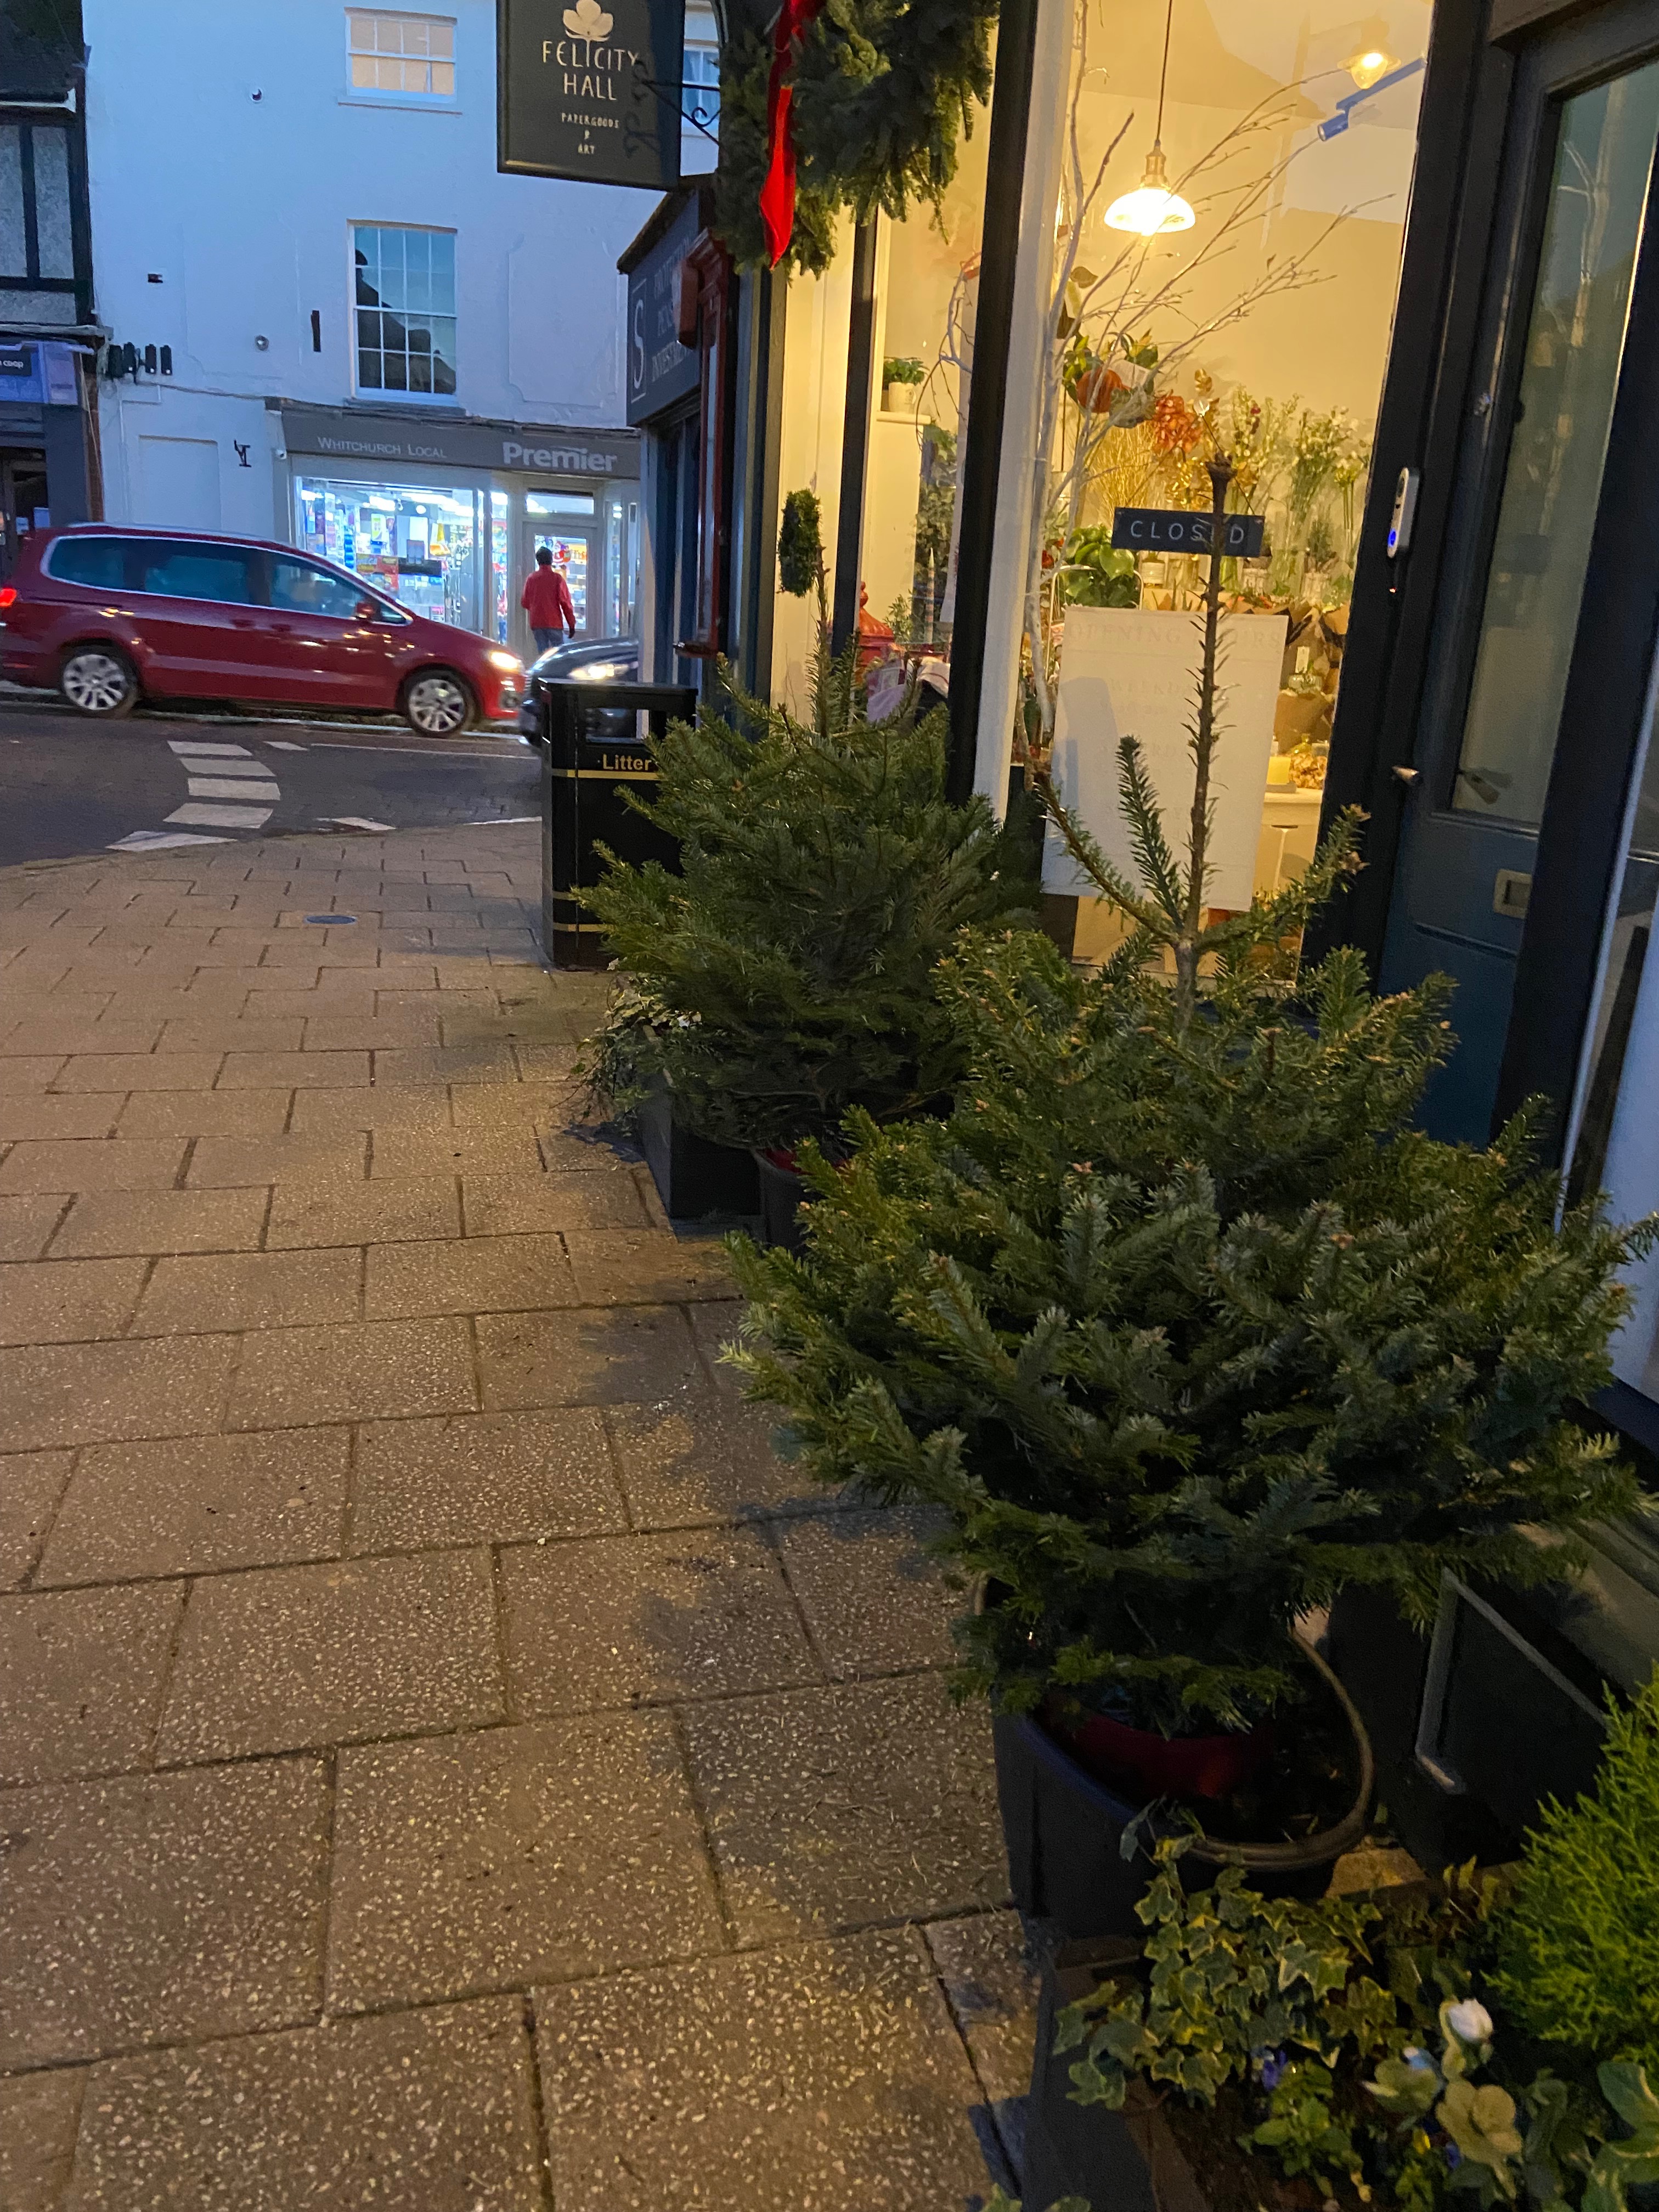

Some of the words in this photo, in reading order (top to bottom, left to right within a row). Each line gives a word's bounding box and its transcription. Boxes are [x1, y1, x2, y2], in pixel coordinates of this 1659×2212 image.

[543, 40, 639, 71] FELICITY
[563, 73, 617, 100] HALL
[318, 436, 400, 455] WHITCHURCH
[408, 444, 447, 458] LOCAL
[503, 442, 618, 472] Premier
[603, 754, 652, 770] Litter
